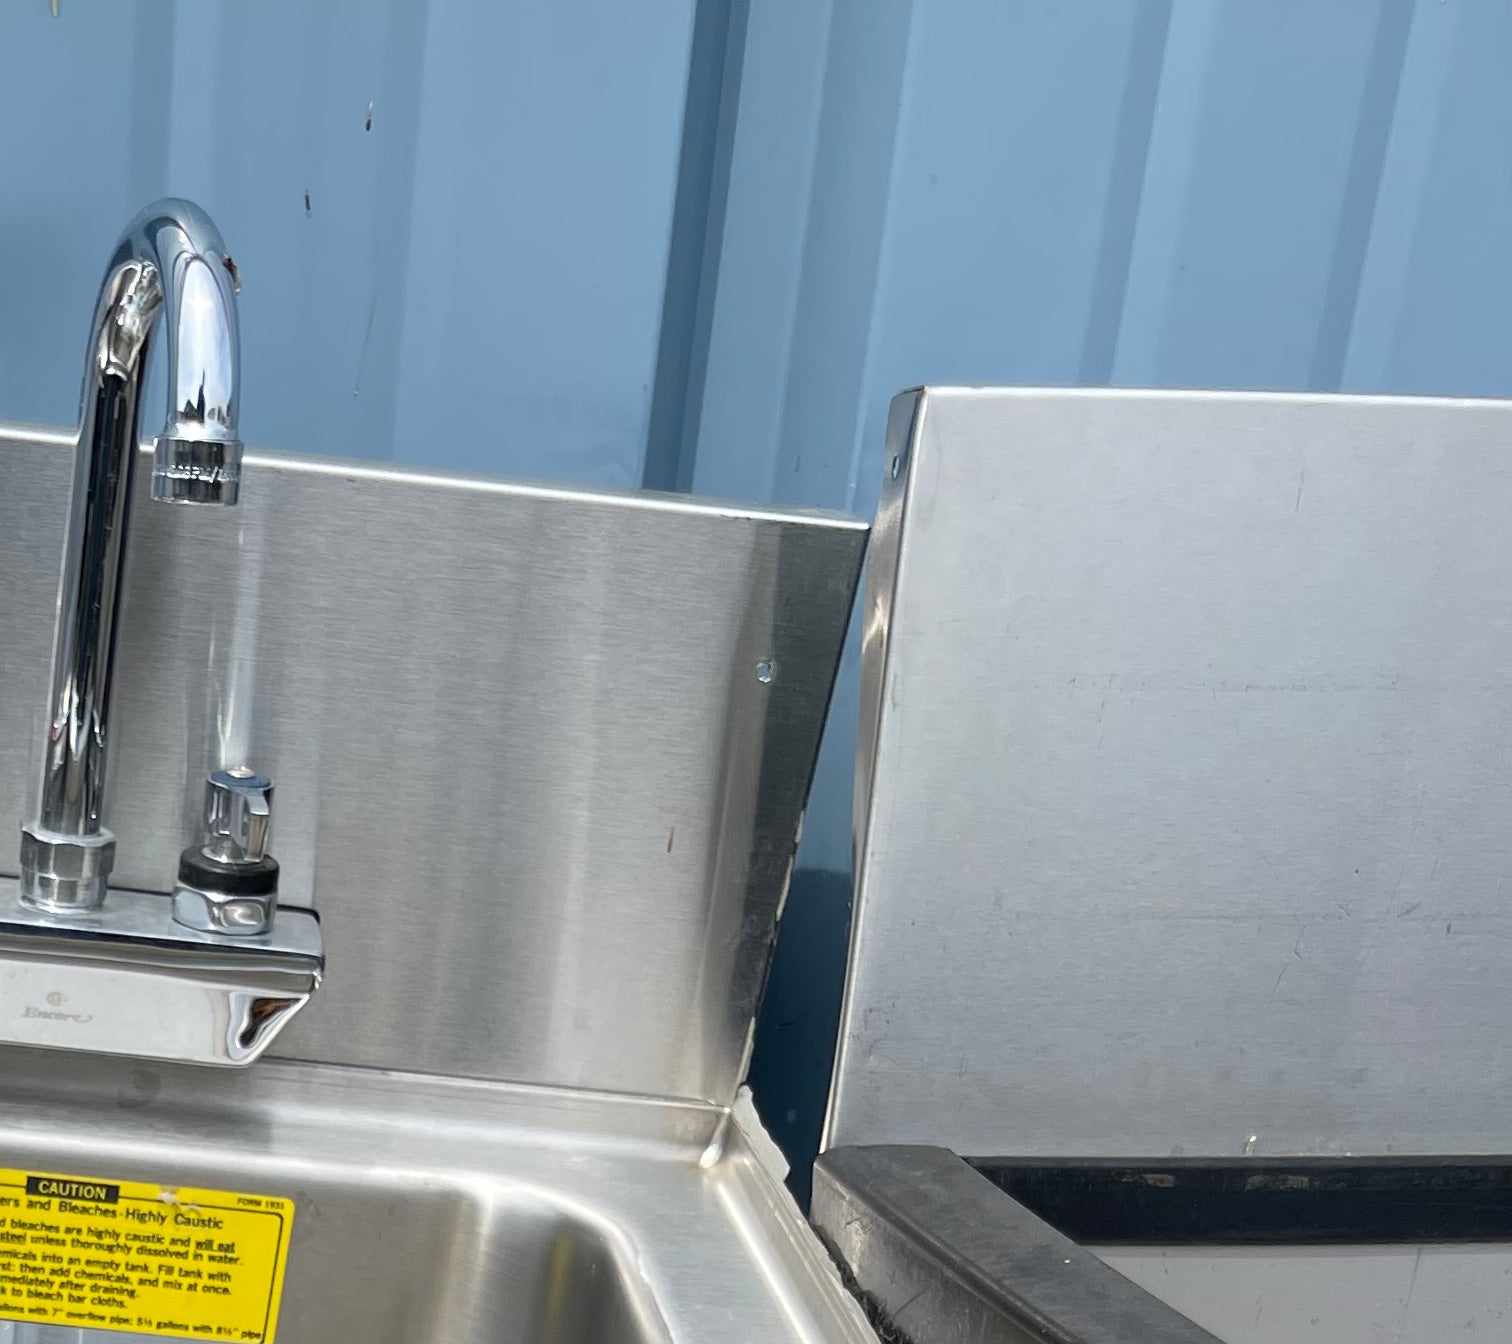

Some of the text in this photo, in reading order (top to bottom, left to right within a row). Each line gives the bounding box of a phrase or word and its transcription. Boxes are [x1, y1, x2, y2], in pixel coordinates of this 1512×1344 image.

[38, 1181, 106, 1199] CAUTION
[237, 1198, 262, 1206] FORM
[27, 1199, 50, 1210] and
[174, 1213, 223, 1229] Caustic
[0, 1232, 26, 1242] steel
[31, 1236, 66, 1246] unless
[71, 1238, 132, 1254] thoroughly
[137, 1246, 188, 1259] dissolved
[193, 1252, 203, 1260] in
[208, 1254, 243, 1265] water.
[11, 1219, 59, 1233] bleaches
[65, 1227, 82, 1235] are
[87, 1226, 120, 1240] highly
[125, 1233, 165, 1244] caustic
[169, 1238, 190, 1246] and
[195, 1240, 214, 1250] will
[218, 1242, 235, 1253] eat
[20, 1263, 45, 1274] then
[49, 1268, 70, 1277] add
[138, 1277, 159, 1287] and
[163, 1280, 182, 1290] mix
[187, 1283, 197, 1292] at
[42, 1252, 63, 1263] into
[85, 1259, 120, 1271] empty
[125, 1263, 152, 1274] tank.
[159, 1264, 174, 1275] Fill
[179, 1268, 202, 1279] tank
[208, 1272, 231, 1282] with
[12, 1287, 22, 1297] to
[27, 1289, 63, 1301] bleach
[68, 1293, 86, 1303] bar
[91, 1297, 127, 1308] cloths.
[59, 1280, 86, 1290] after
[90, 1283, 139, 1299] draining.
[29, 1307, 48, 1315] with
[67, 1311, 106, 1321] overflow
[157, 1321, 188, 1331] gallons
[193, 1325, 212, 1333] with
